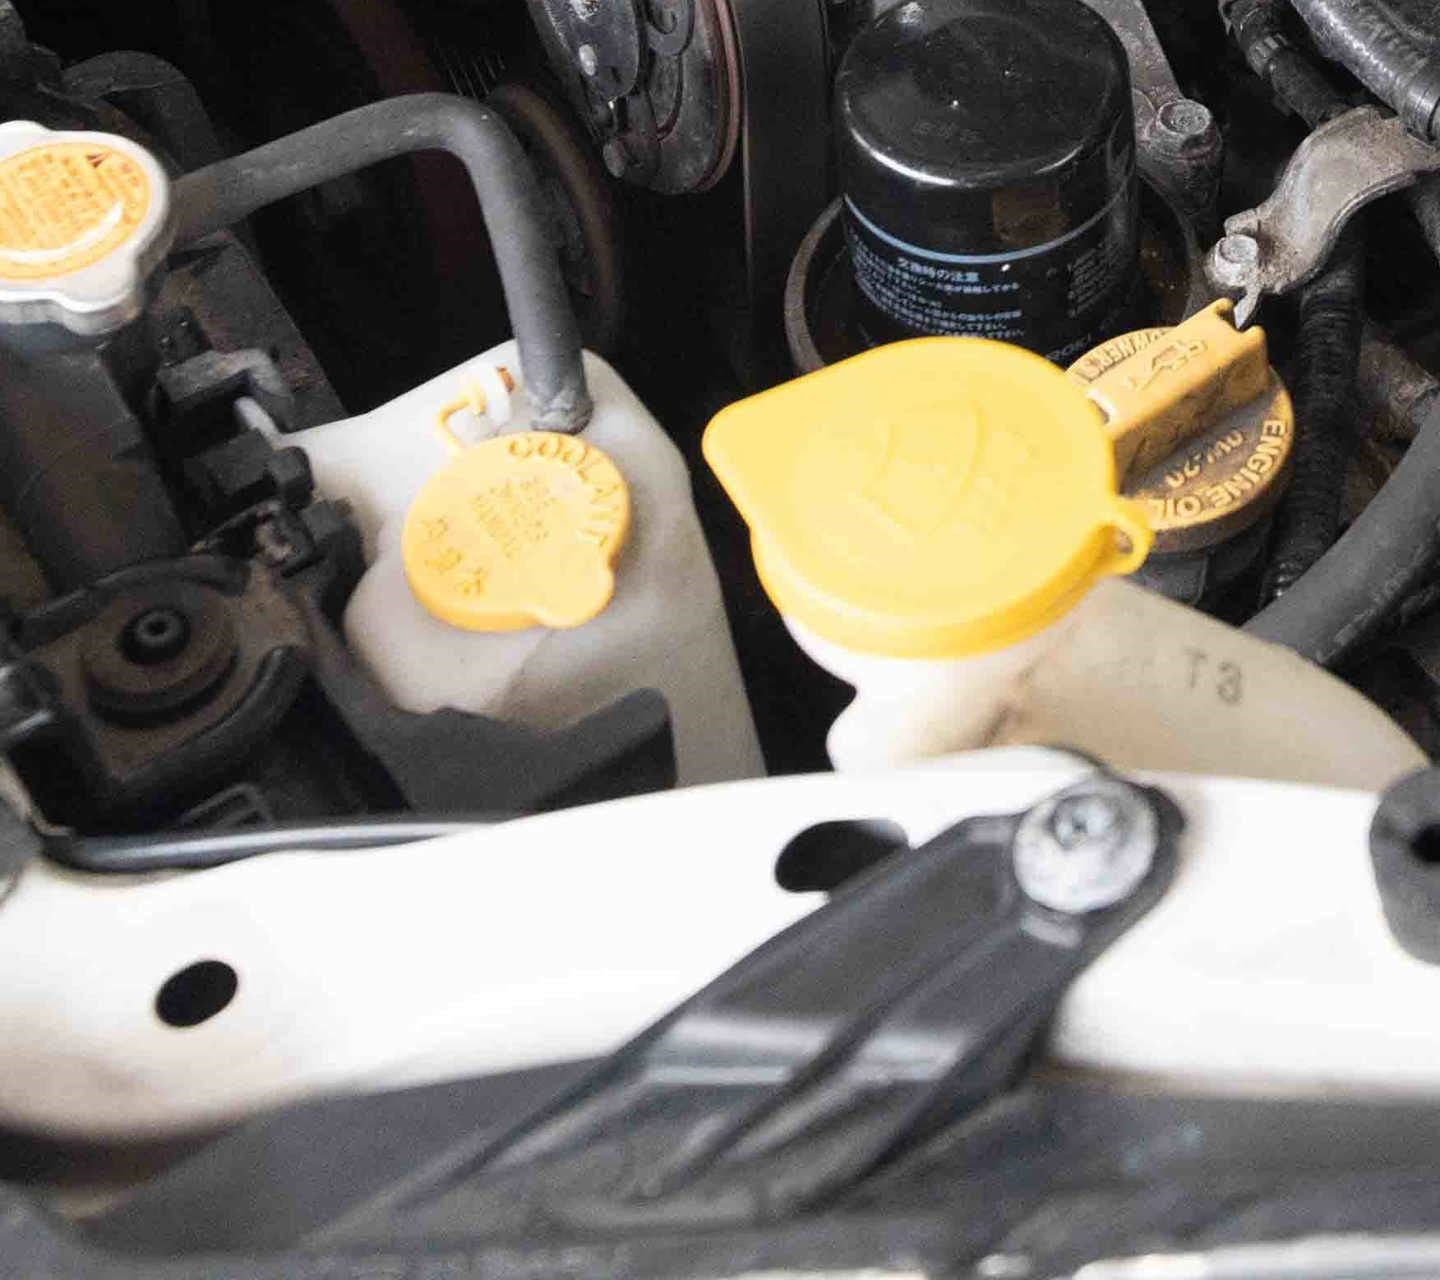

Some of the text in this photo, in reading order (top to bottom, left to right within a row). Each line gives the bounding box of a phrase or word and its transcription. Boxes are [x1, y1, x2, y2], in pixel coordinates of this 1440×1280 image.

[508, 436, 621, 548] COOLANT
[1147, 419, 1287, 518] ENGINE OIL
